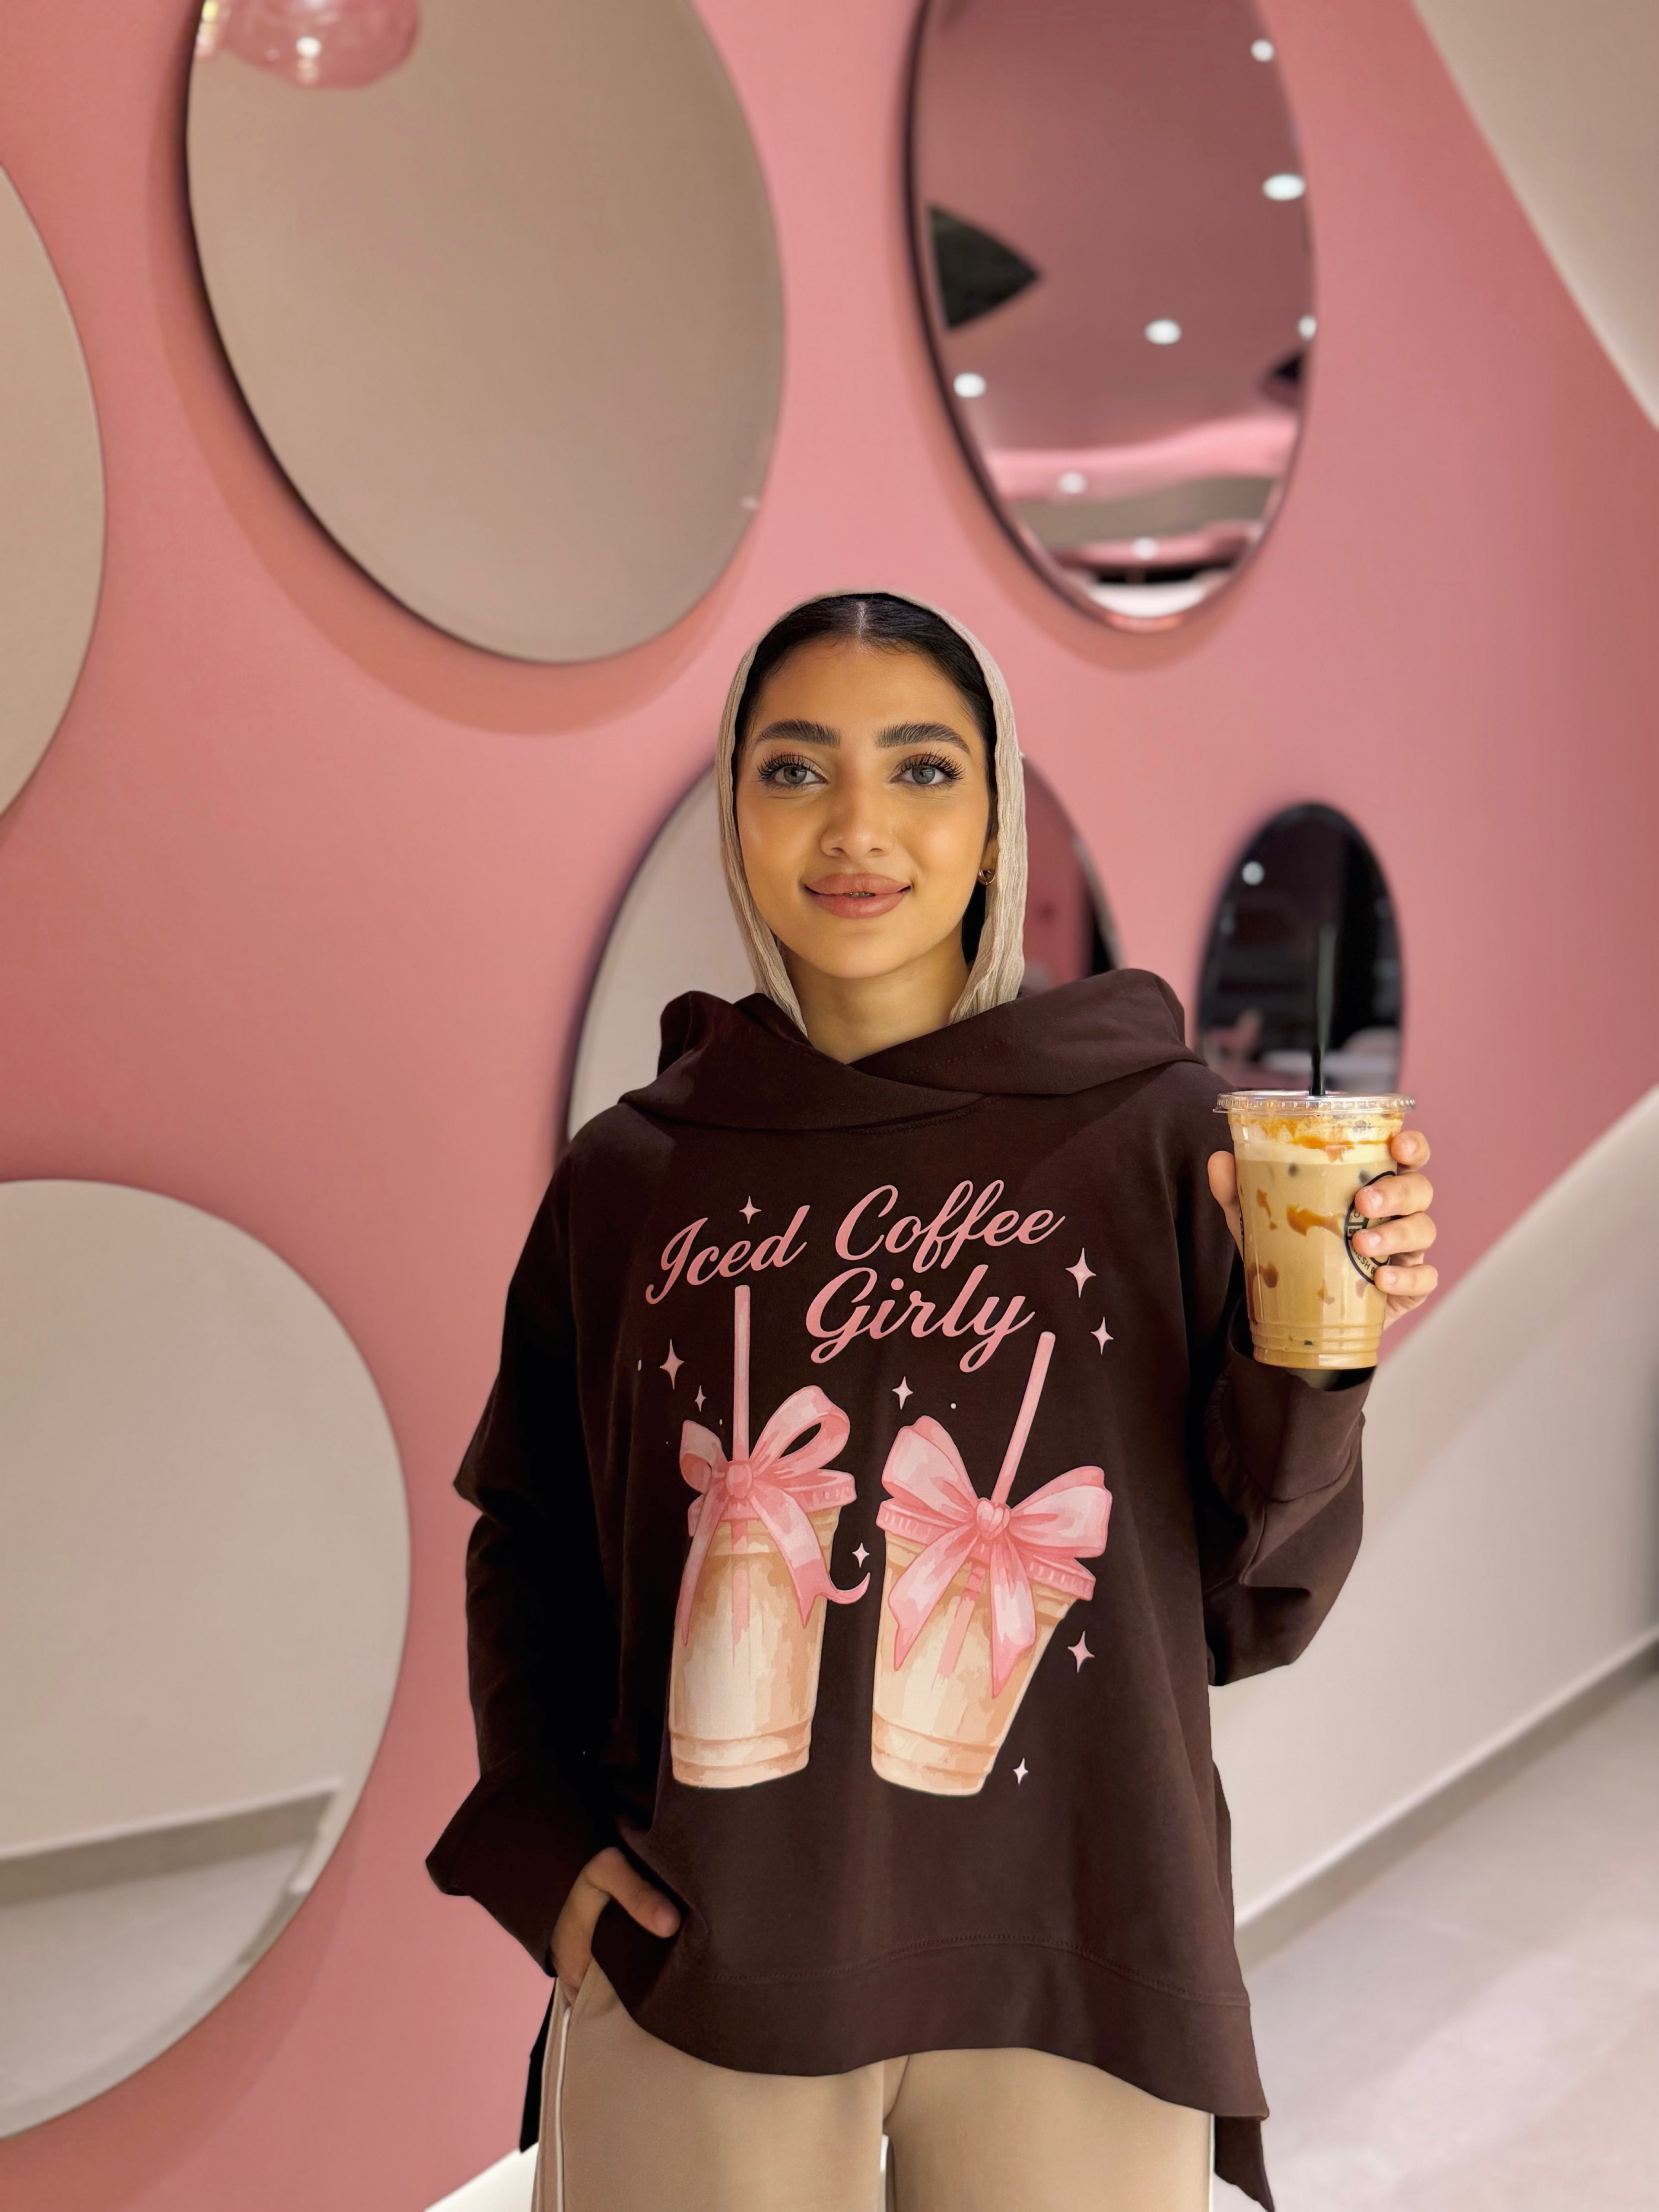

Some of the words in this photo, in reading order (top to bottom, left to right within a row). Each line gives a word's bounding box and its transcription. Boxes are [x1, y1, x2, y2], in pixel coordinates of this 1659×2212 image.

[645, 1205, 810, 1305] Iced
[834, 1179, 1066, 1273] Coffee
[805, 1264, 1036, 1373] Girly
